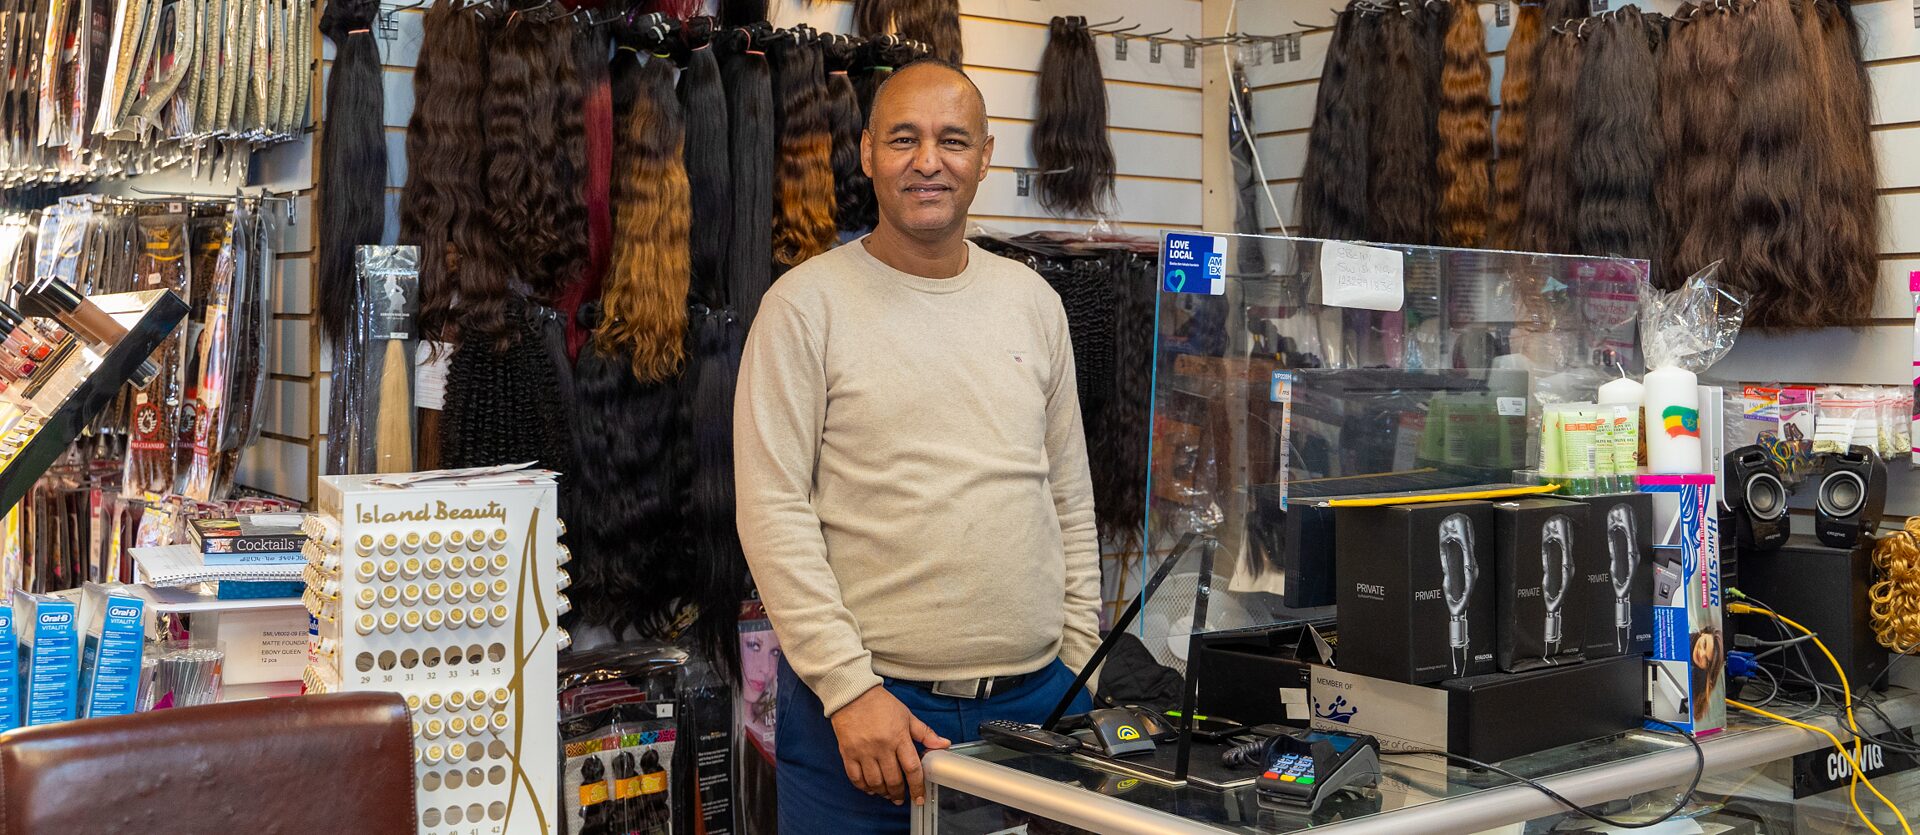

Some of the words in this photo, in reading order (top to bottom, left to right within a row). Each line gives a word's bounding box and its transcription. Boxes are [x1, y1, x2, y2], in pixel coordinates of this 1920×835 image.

[1170, 239, 1190, 250] LOVE
[1169, 249, 1194, 260] LOCAL
[356, 502, 431, 525] Island
[434, 500, 507, 525] Beauty
[236, 538, 295, 551] Cocktails
[1356, 582, 1385, 596] PRIVATE
[1415, 588, 1441, 601] PRIVATE
[1517, 586, 1541, 599] PRIVATE
[111, 607, 137, 617] Oral-B
[41, 614, 69, 623] Oral-B
[360, 676, 370, 684] 29
[383, 675, 393, 683] 30
[405, 673, 414, 681] 31
[426, 672, 436, 680] 32
[448, 670, 458, 678] 33
[470, 669, 480, 677] 34
[491, 667, 501, 675] 35
[1316, 677, 1343, 689] MEMBER
[491, 826, 501, 834] 42
